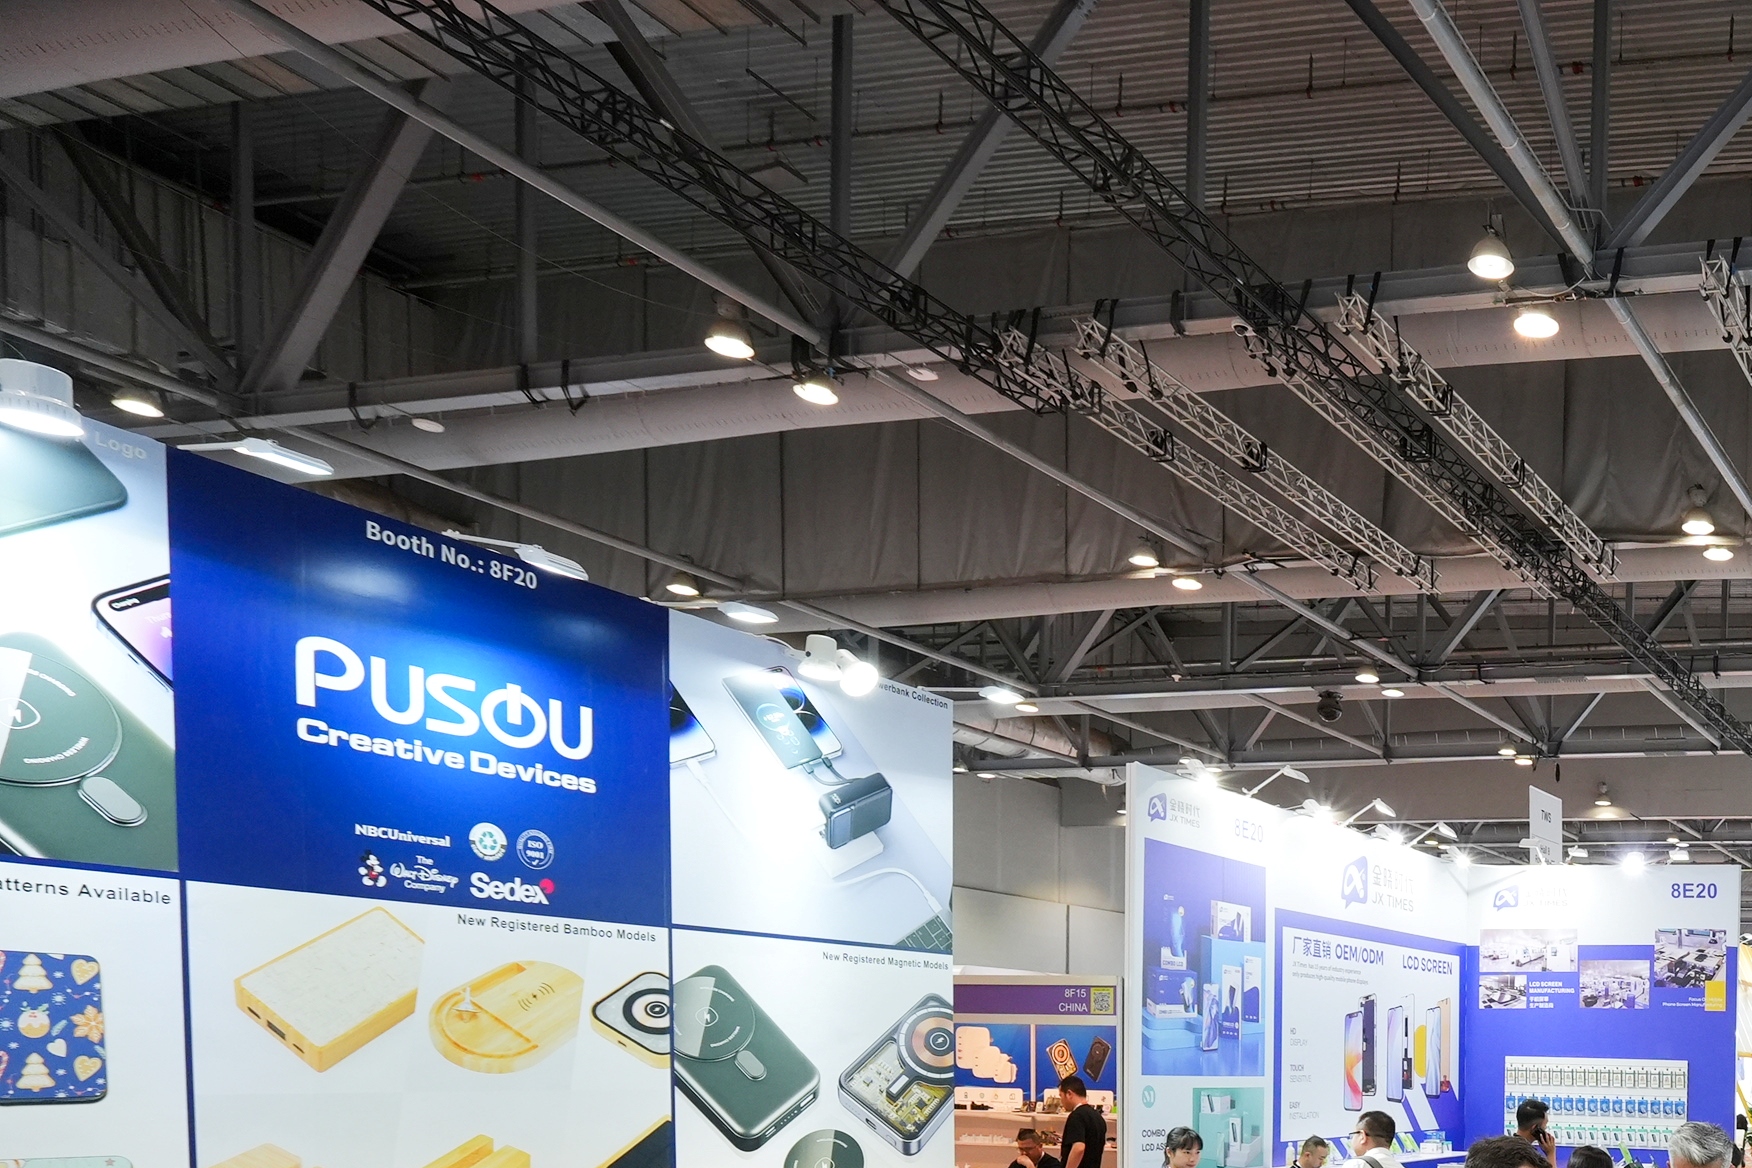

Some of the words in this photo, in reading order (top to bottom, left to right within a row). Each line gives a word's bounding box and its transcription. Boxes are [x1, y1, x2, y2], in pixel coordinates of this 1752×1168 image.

[365, 520, 435, 558] Booth
[440, 544, 484, 574] No.:
[489, 560, 538, 590] 8F20
[295, 636, 593, 760] PUSOU
[876, 682, 910, 697] werbank
[911, 689, 949, 710] Collection
[296, 717, 466, 770] Creative
[469, 750, 597, 794] Devices
[1169, 813, 1179, 823] JX
[1180, 816, 1201, 829] TIMES
[1234, 818, 1264, 843] 8E20
[354, 823, 451, 848] NBCUniversal
[527, 839, 544, 850] ISO
[416, 855, 434, 865] The
[525, 849, 545, 859] 9001
[77, 884, 171, 905] Available
[403, 879, 447, 894] Company
[469, 872, 554, 904] Sedex
[1671, 882, 1718, 899] 8E20
[1372, 891, 1384, 906] JX
[1387, 894, 1414, 912] TIMES
[457, 914, 486, 927] New
[490, 916, 559, 934] Registered
[563, 923, 613, 939] Bamboo
[616, 929, 656, 942] Models
[822, 951, 840, 963] New
[842, 953, 885, 966] Registered
[887, 956, 921, 969] Magnetic
[923, 959, 949, 970] Models
[1292, 935, 1332, 960] 厂家直销
[1335, 943, 1384, 966] OEM/ODM
[1402, 954, 1420, 970] LCD
[1420, 957, 1453, 975] SCREEN
[1064, 988, 1087, 998] 8F15
[1058, 1002, 1088, 1012] CHINA
[1141, 1128, 1166, 1138] COMBO
[1141, 1142, 1155, 1152] LCD
